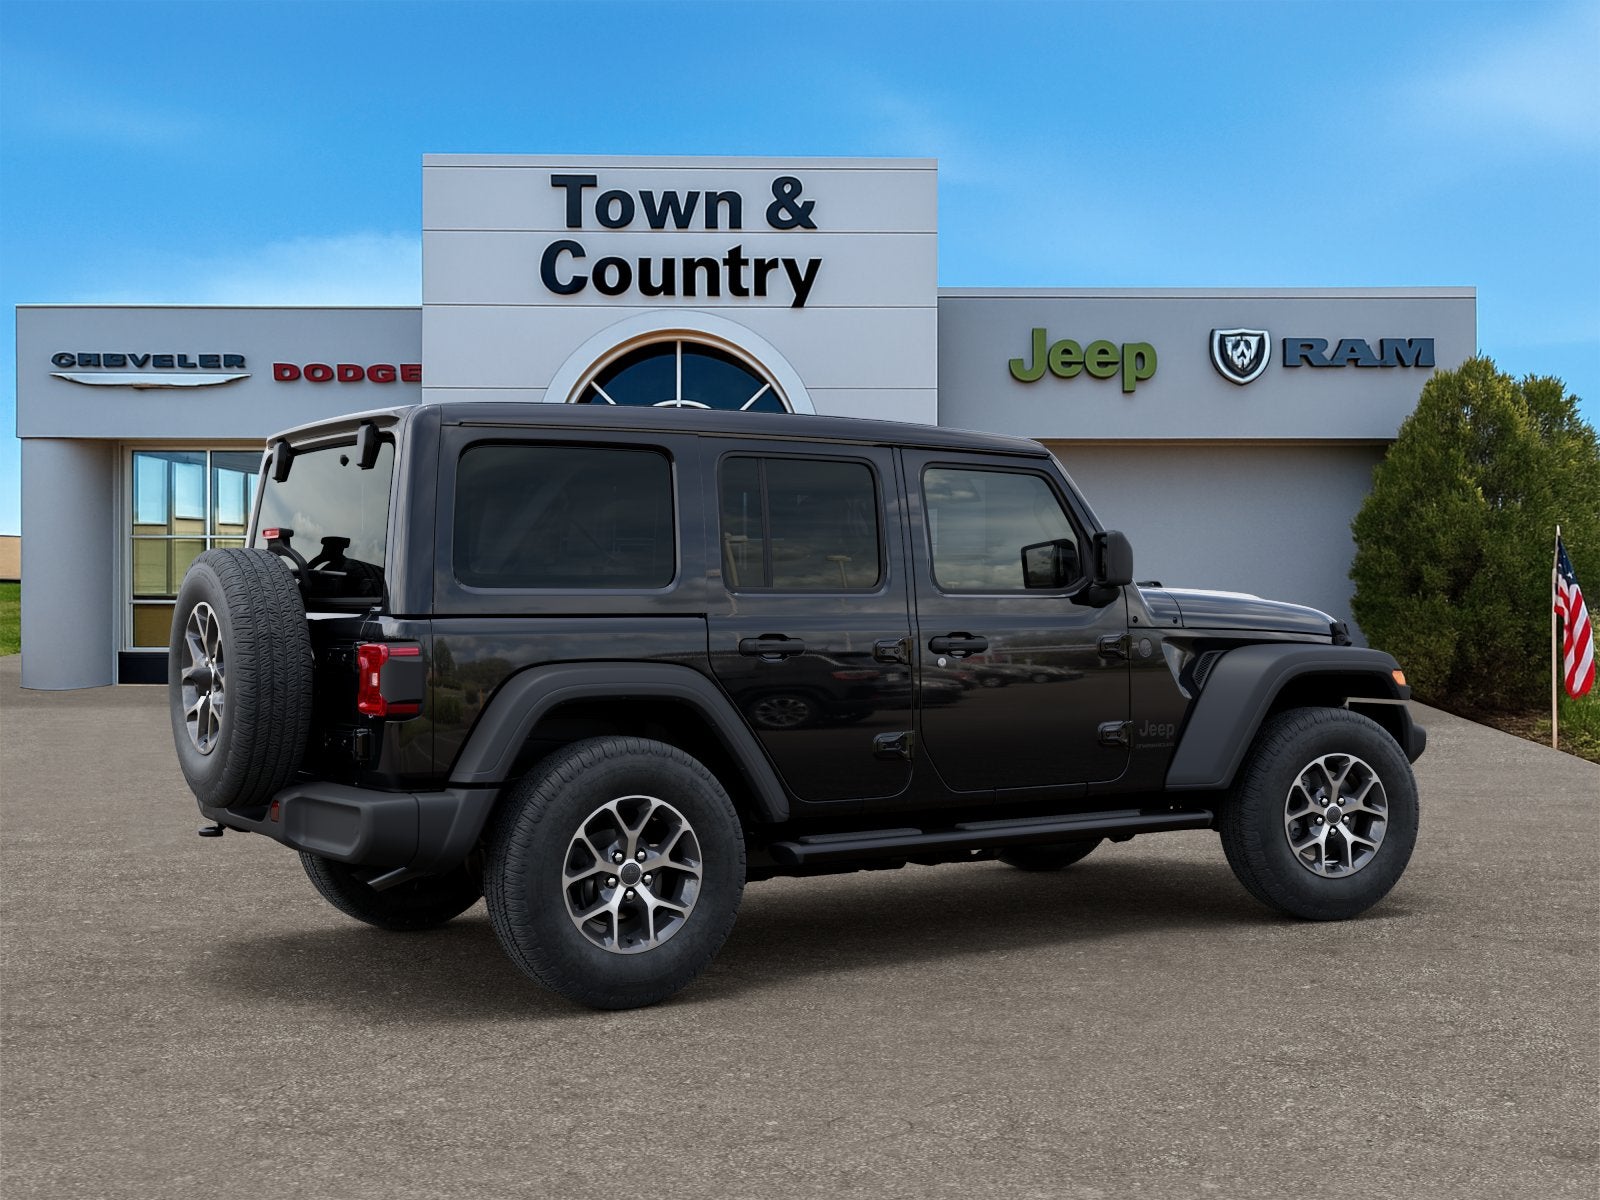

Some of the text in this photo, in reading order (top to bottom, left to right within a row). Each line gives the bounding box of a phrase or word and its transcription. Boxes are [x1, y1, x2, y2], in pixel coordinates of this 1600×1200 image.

[551, 174, 817, 229] Town &
[540, 239, 822, 308] Country
[273, 363, 421, 382] DODGE
[1009, 328, 1157, 392] Jeep
[1283, 338, 1434, 367] RAM
[1138, 720, 1175, 739] Jeep
